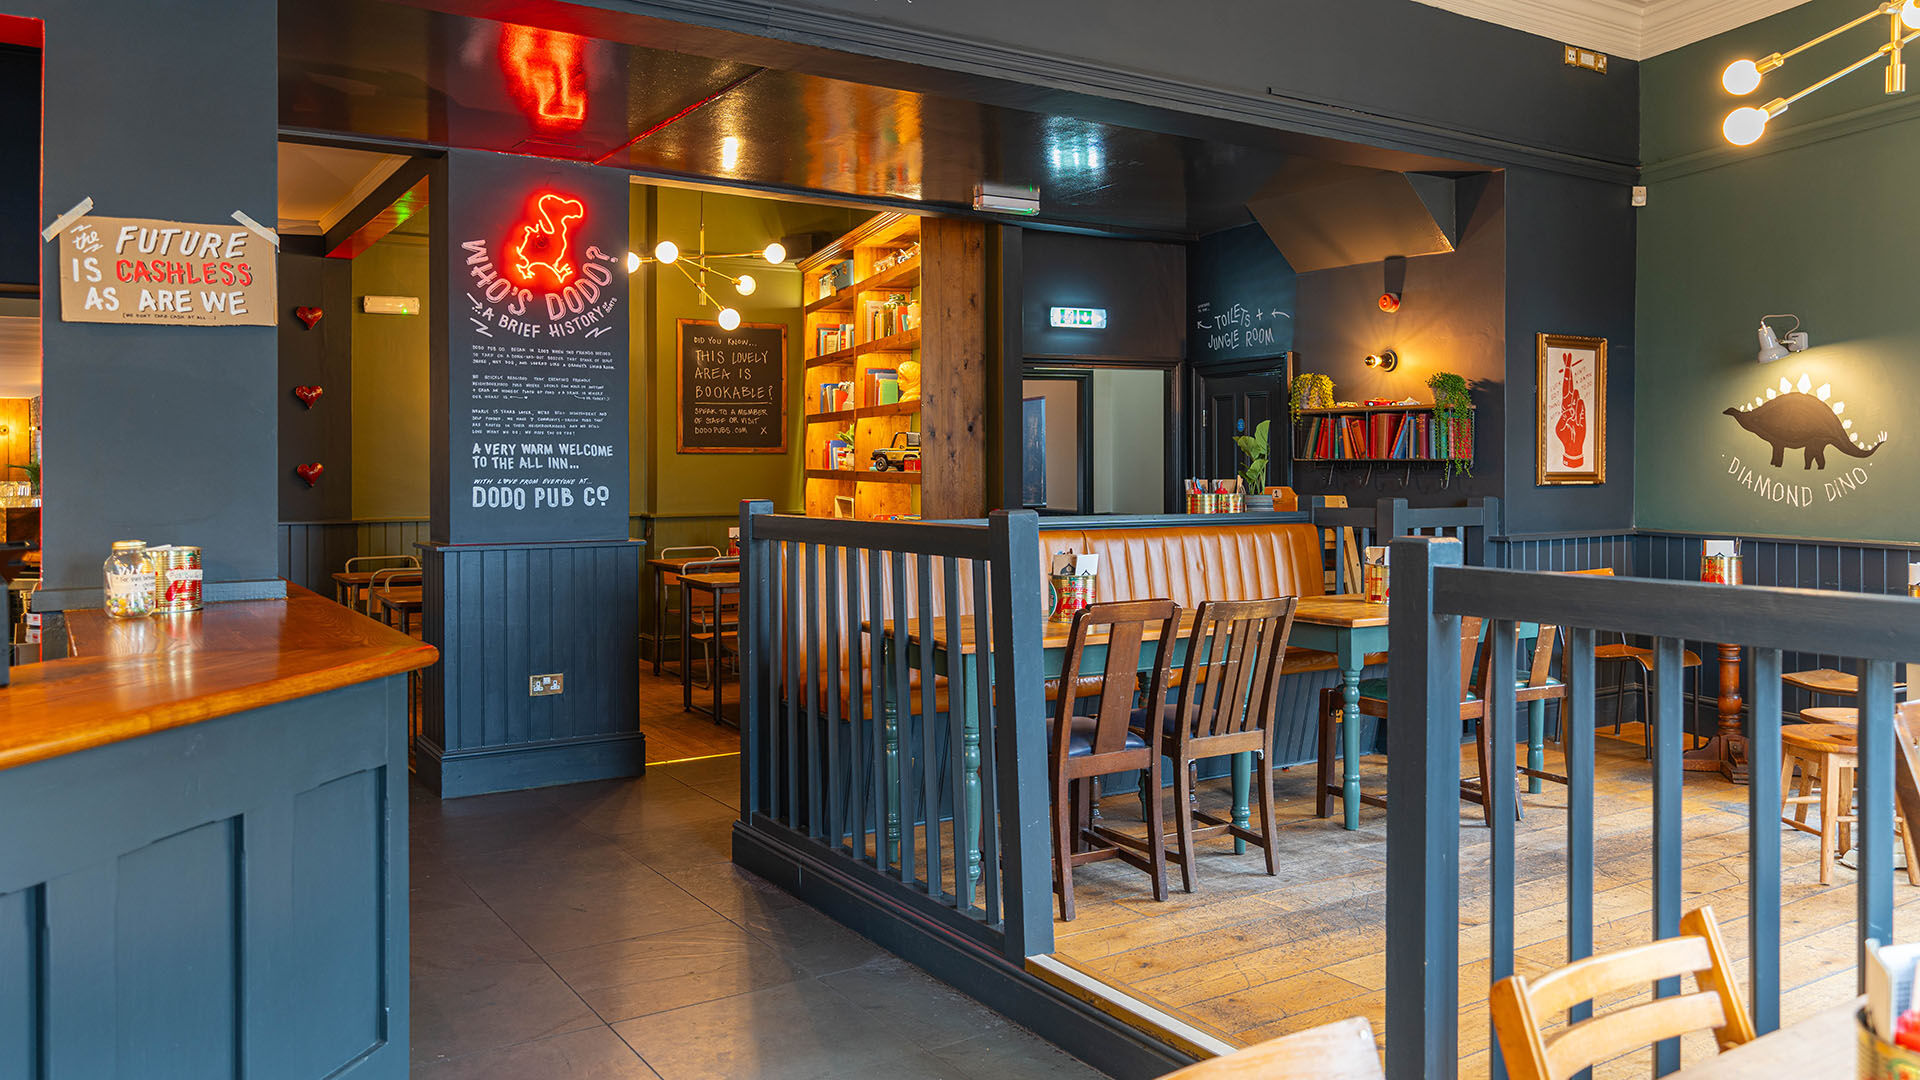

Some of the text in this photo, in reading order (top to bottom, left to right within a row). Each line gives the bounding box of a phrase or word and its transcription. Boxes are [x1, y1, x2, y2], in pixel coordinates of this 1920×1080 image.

[72, 226, 248, 258] the FUTURE
[72, 258, 253, 286] IS CASHLESS
[461, 240, 618, 321] WHO'S DODO?
[84, 286, 248, 316] AS ARE WE
[498, 315, 540, 338] BRIEF
[549, 306, 604, 338] HISTORY
[1214, 303, 1251, 330] TOILETS
[1208, 328, 1274, 350] JUNGLE ROOM
[696, 350, 768, 364] THIS LOVELY
[695, 367, 752, 380] AREA IS
[695, 385, 773, 400] BOOKABLE?
[472, 443, 614, 457] A VERY WARM WELCOME
[472, 456, 579, 470] TO THE ALL INN...
[1728, 456, 1868, 507] DIAMOND DINO
[472, 487, 526, 510] DODO
[535, 487, 574, 508] PUB
